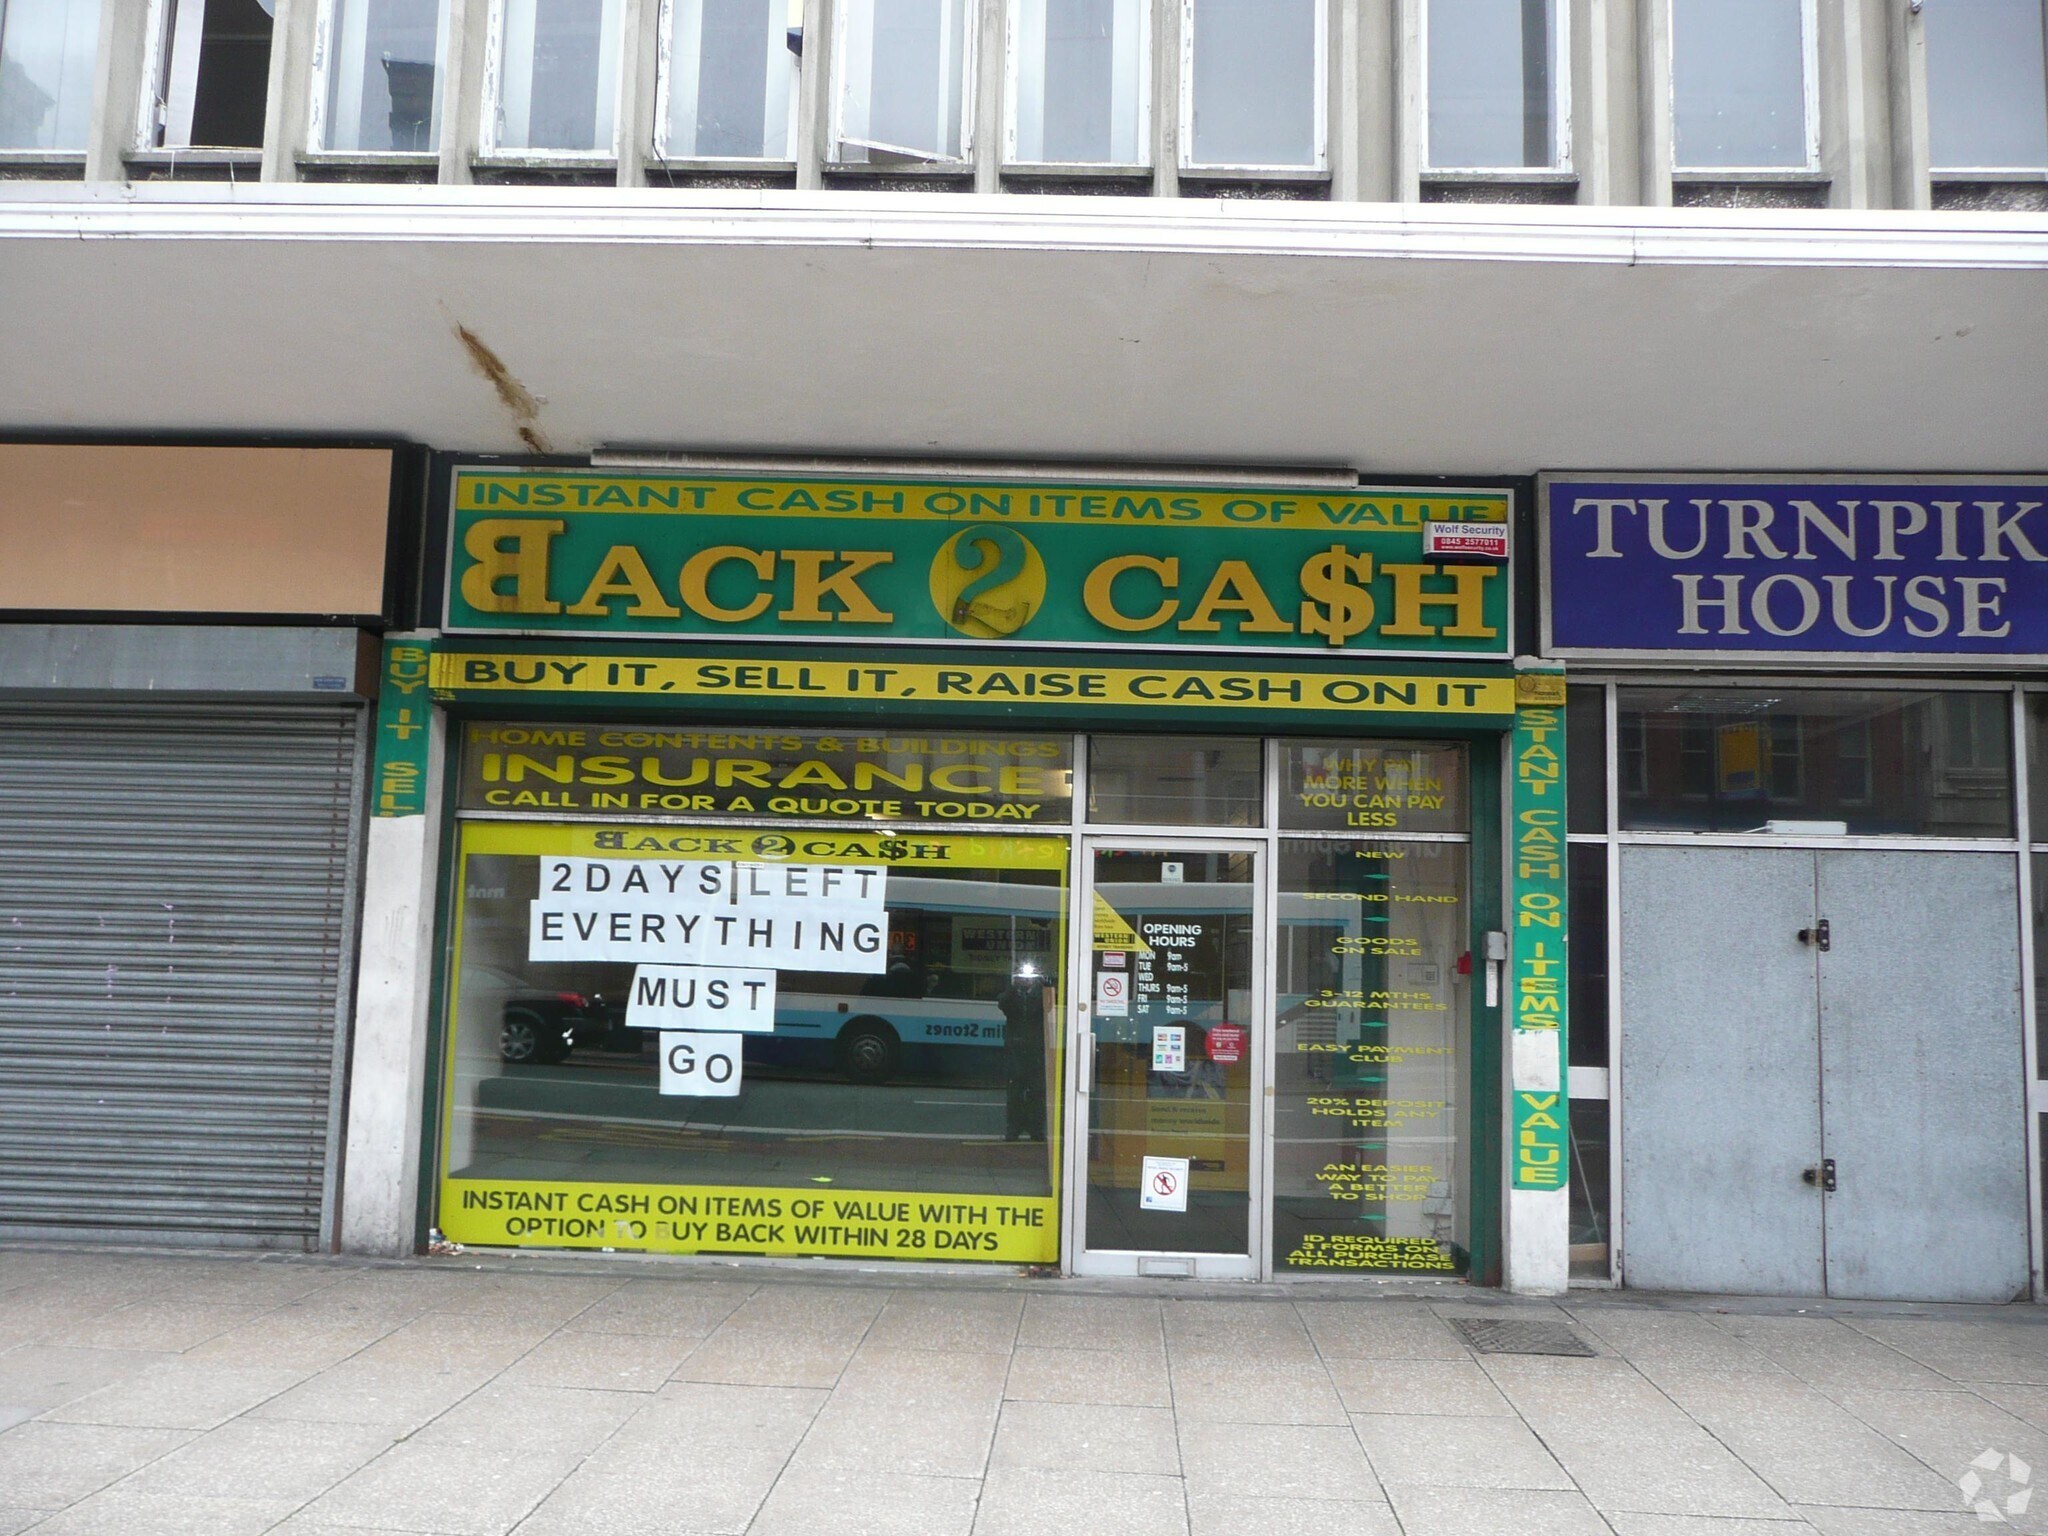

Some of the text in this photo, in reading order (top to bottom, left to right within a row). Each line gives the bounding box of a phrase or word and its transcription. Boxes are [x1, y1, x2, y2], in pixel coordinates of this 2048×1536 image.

[473, 482, 717, 509] INSTANT
[736, 488, 905, 514] CASH
[924, 492, 1010, 516] ON
[1029, 494, 1203, 520] ITEMS
[1221, 499, 1298, 523] OF
[1434, 524, 1506, 537] Wolf Security
[1572, 497, 2048, 562] TURNPIK
[1464, 538, 1499, 546] 2577011
[460, 518, 895, 624] BACK
[1083, 544, 1498, 646] CA$H
[1671, 573, 2012, 638] HOUSE
[389, 647, 428, 694] BUY
[465, 660, 1487, 707] BUY IT, SELL IT, RAISE CASH ON IT
[386, 708, 422, 740] IT
[471, 728, 1060, 759] HOME CONTENTS & BUILDINGS
[1323, 758, 1377, 772] WHY
[481, 753, 1045, 796] INSURANCE
[1304, 776, 1441, 791] MORE WHEN
[485, 789, 1042, 820] CALL IN FOR A QUOTE TODAY
[1301, 793, 1445, 810] YOU CAN PAY
[1347, 812, 1398, 827] LESS
[594, 831, 743, 854] BACK
[802, 839, 951, 861] CA$H
[1519, 809, 1560, 879] CASH
[1356, 851, 1405, 859] NEW
[749, 867, 878, 899] LEFT
[1302, 893, 1458, 904] SECOND HAND
[1519, 893, 1560, 928] ON
[540, 911, 882, 954] EVERYTHING
[1143, 924, 1202, 936] OPENING
[1148, 936, 1197, 947] HOURS
[1336, 937, 1418, 946] GOODS
[1139, 951, 1156, 960] MON
[1331, 946, 1422, 956] ON SALE
[1138, 962, 1152, 971] TUE
[1138, 972, 1154, 981] WED
[1138, 983, 1160, 993] THURS
[1520, 942, 1560, 1030] ITEMS
[637, 976, 768, 1012] MUST
[1137, 994, 1148, 1003] FRI
[1320, 989, 1432, 1000] 3-12 MTHS
[1137, 1005, 1150, 1014] SAT
[1304, 1000, 1447, 1011] GUARANTEES
[1297, 1043, 1452, 1055] EASY PAYMENT
[667, 1044, 735, 1084] GO
[1349, 1054, 1403, 1063] CLUB
[1306, 1097, 1446, 1109] 20% DEPOSIT
[1311, 1108, 1439, 1119] HOLDS ANY
[1352, 1119, 1403, 1128] ITEM
[1520, 1093, 1561, 1184] VALUE
[1323, 1163, 1433, 1173] AN EASIER
[1315, 1173, 1440, 1184] WAY TO PAY
[1328, 1182, 1428, 1193] A BETTER
[1330, 1192, 1427, 1202] TO SHOP
[462, 1190, 1044, 1228] INSTANT CASH ON ITEMS OF VALUE WITH THE
[505, 1217, 607, 1239] OPTION
[716, 1222, 786, 1244] BACK
[793, 1225, 892, 1249] WITHIN
[896, 1228, 927, 1249] 28
[934, 1229, 999, 1252] DAYS
[1304, 1234, 1437, 1245] ID REQUIRED
[1302, 1242, 1440, 1254] 3 FORMS ON
[1289, 1250, 1451, 1263] ALL PURCHASE
[1285, 1258, 1455, 1270] TRANSACTIONS
